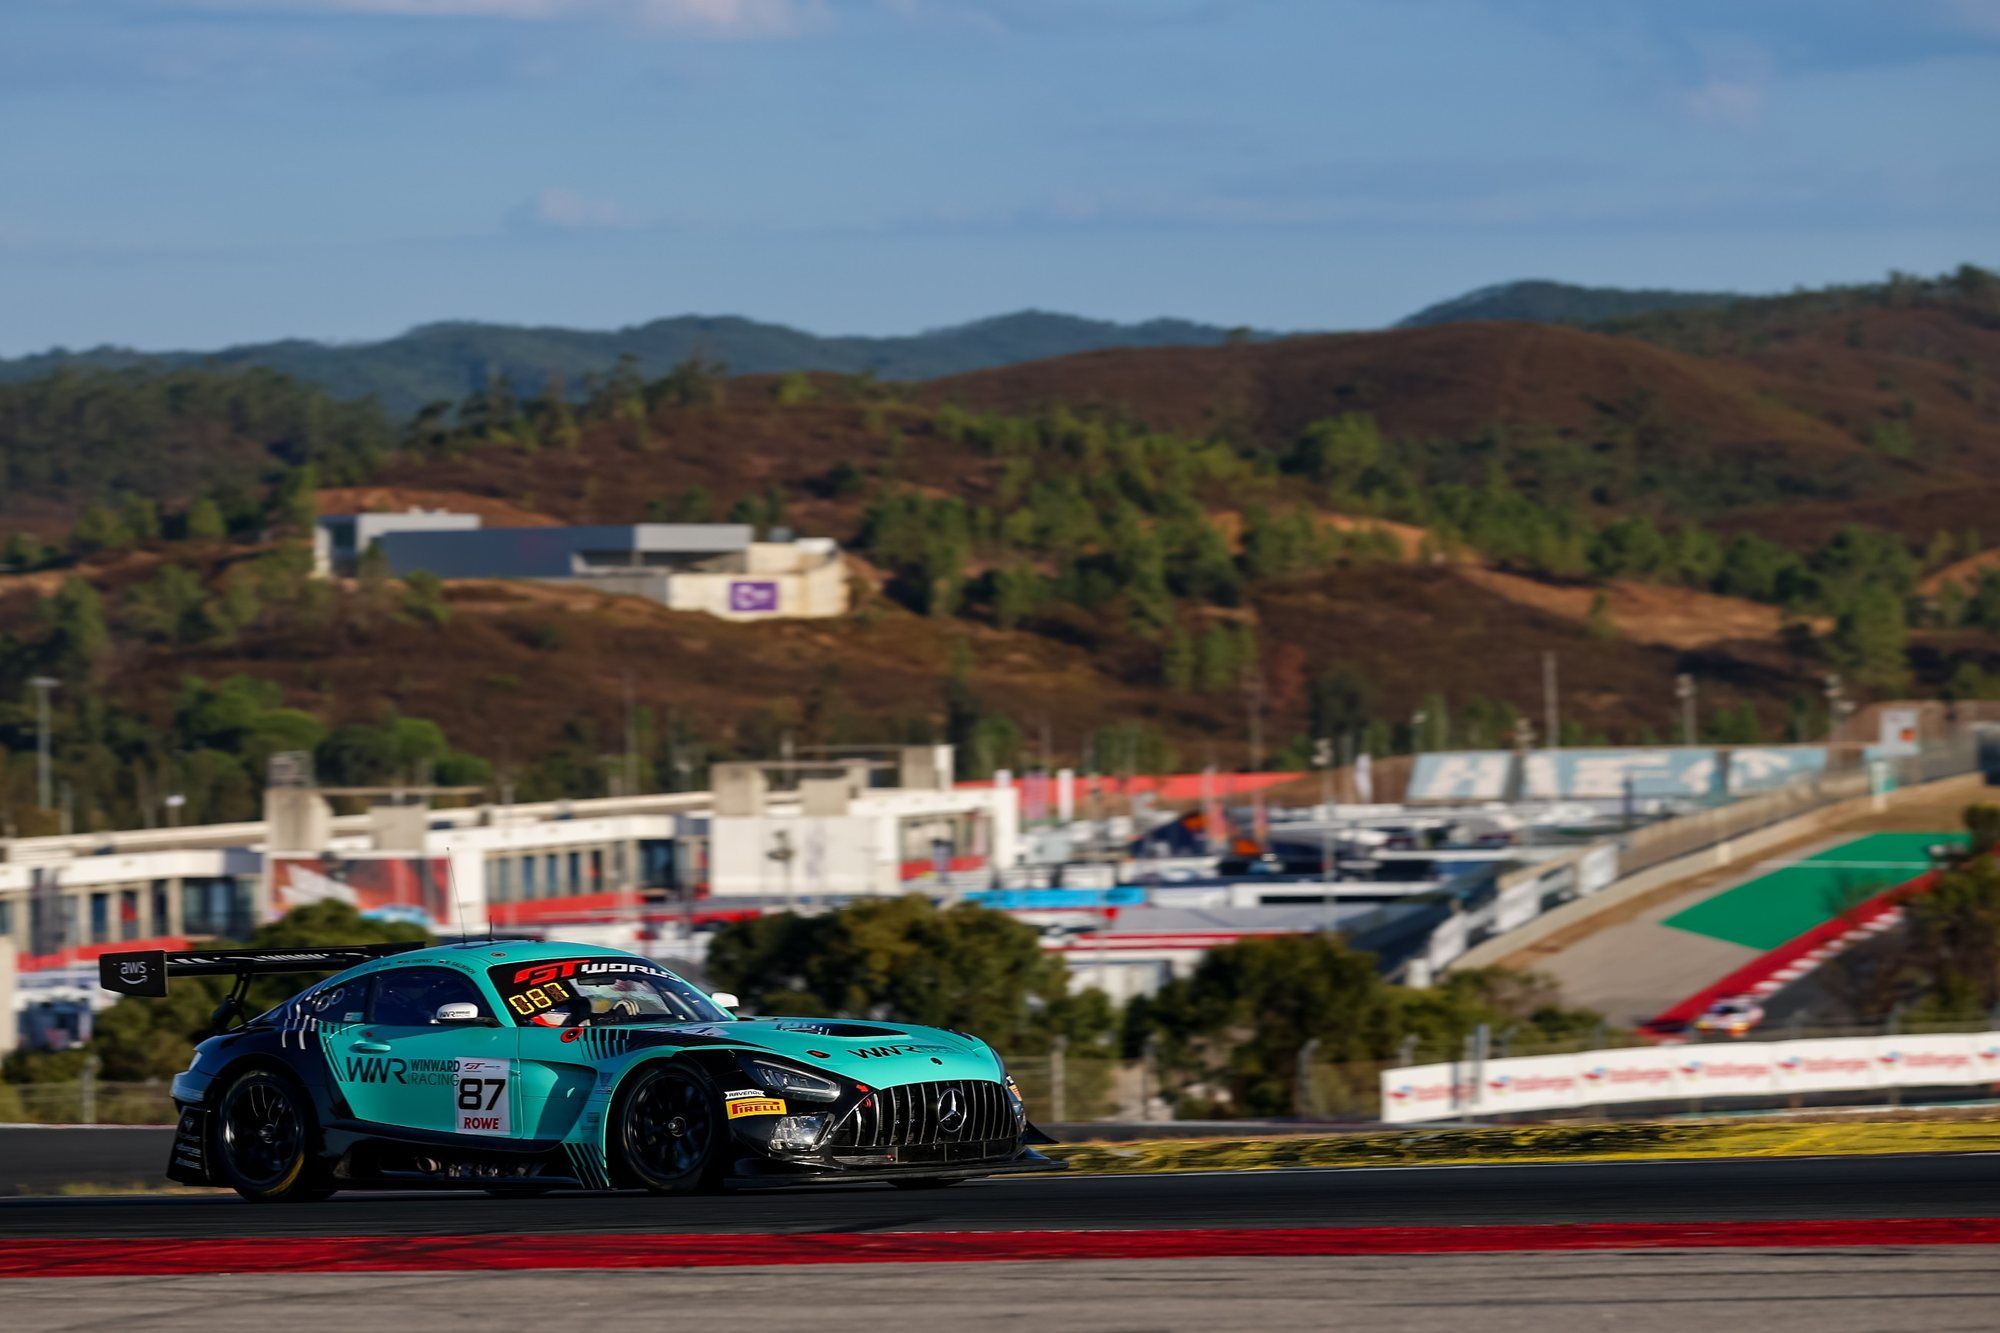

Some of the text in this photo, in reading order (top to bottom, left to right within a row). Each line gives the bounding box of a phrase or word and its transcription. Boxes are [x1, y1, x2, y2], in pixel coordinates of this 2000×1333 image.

[120, 961, 147, 974] aws
[410, 1059, 460, 1073] WINWARD
[411, 1072, 459, 1087] RACING
[458, 1078, 506, 1111] 87
[731, 1101, 781, 1115] PIRELLI
[464, 1116, 499, 1130] ROWE
